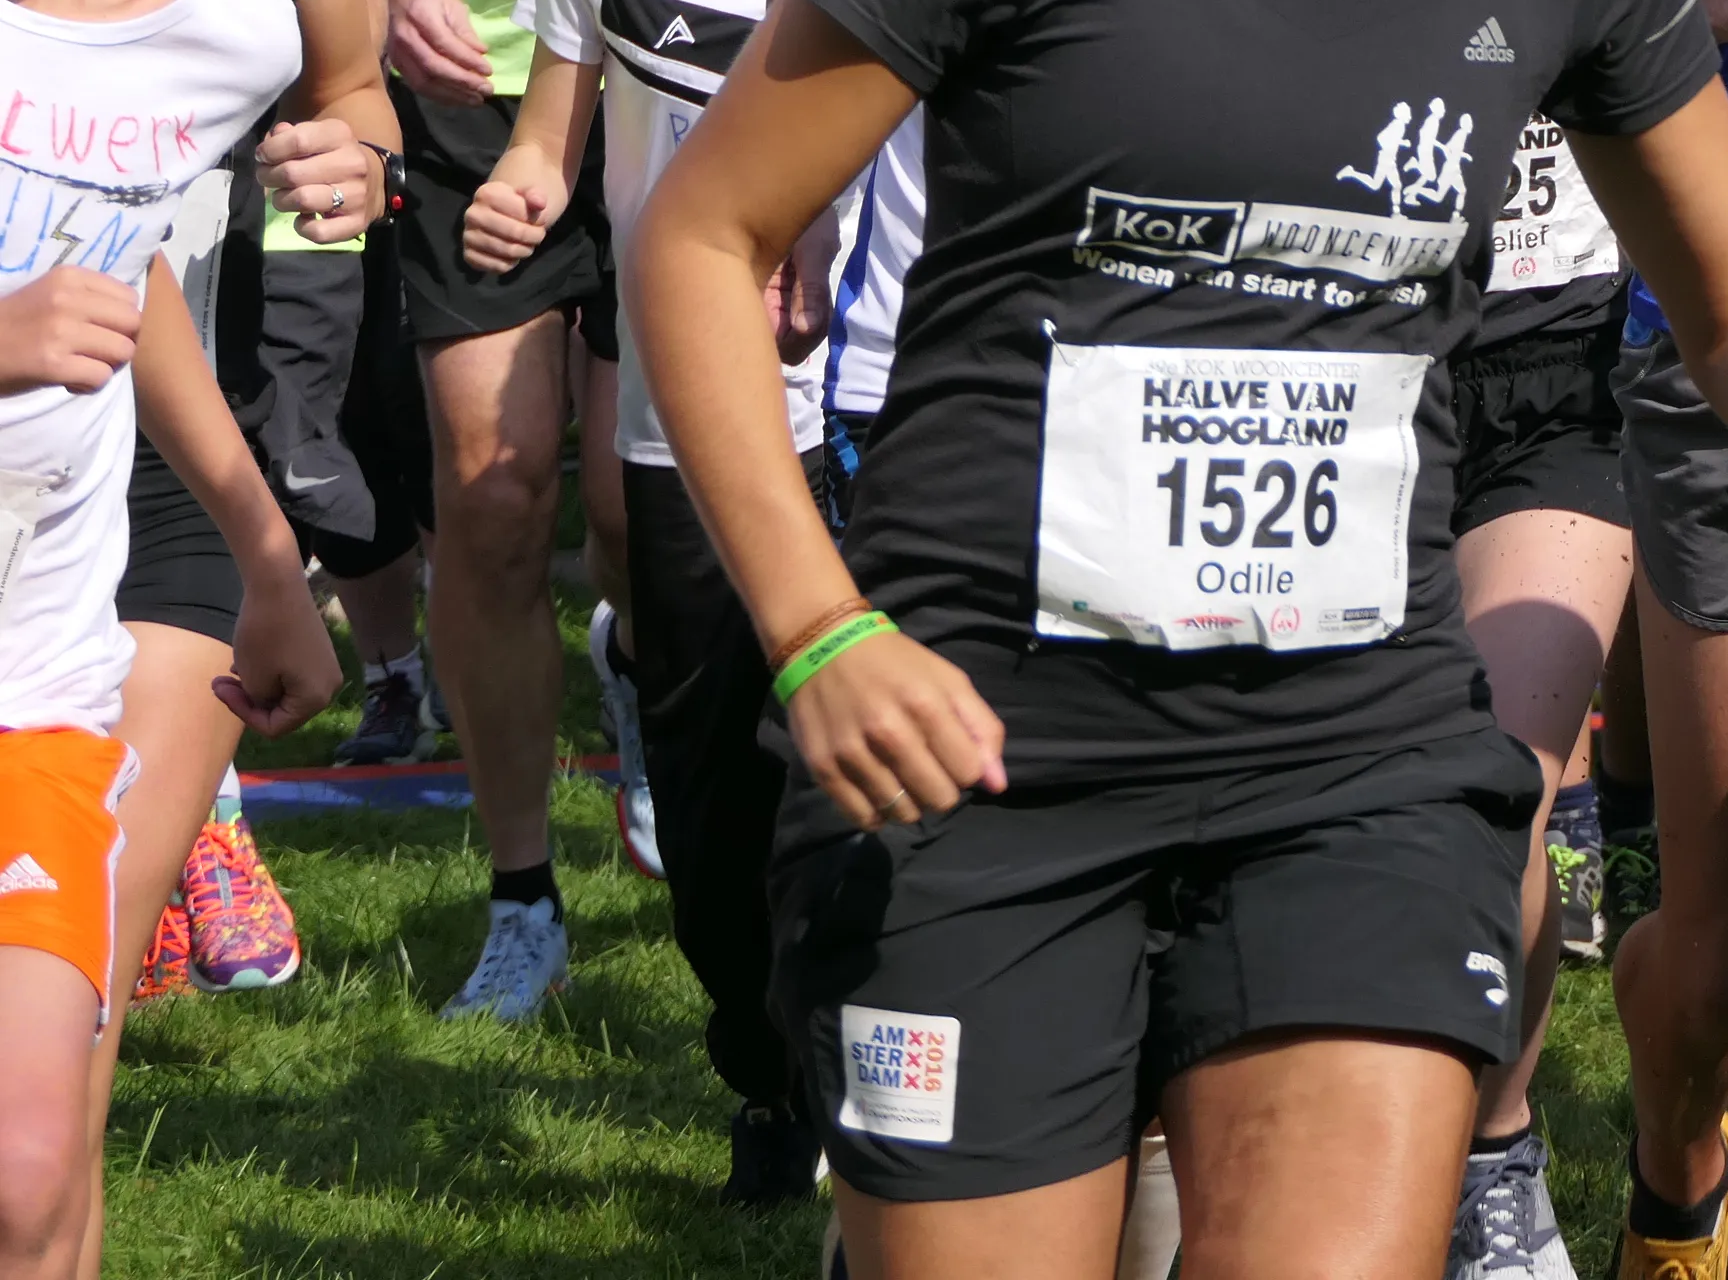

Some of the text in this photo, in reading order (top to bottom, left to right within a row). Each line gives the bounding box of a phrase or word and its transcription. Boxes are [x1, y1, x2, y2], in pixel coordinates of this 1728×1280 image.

[1464, 45, 1516, 63] adidas
[1261, 220, 1449, 268] WOONCENTER
[1494, 224, 1550, 253] elief
[1072, 247, 1176, 288] Wonen
[1242, 271, 1317, 301] start
[1184, 359, 1228, 376] KOK
[1233, 360, 1361, 378] WOONCENTER
[1143, 378, 1357, 412] HALVE VAN
[1142, 414, 1350, 447] HOOGLAND
[1157, 458, 1339, 549] 1526
[1196, 562, 1294, 595] Odile
[0, 876, 59, 894] didas
[851, 1041, 904, 1067] STER
[871, 1024, 945, 1092] AM 2016
[857, 1064, 901, 1088] DAM
